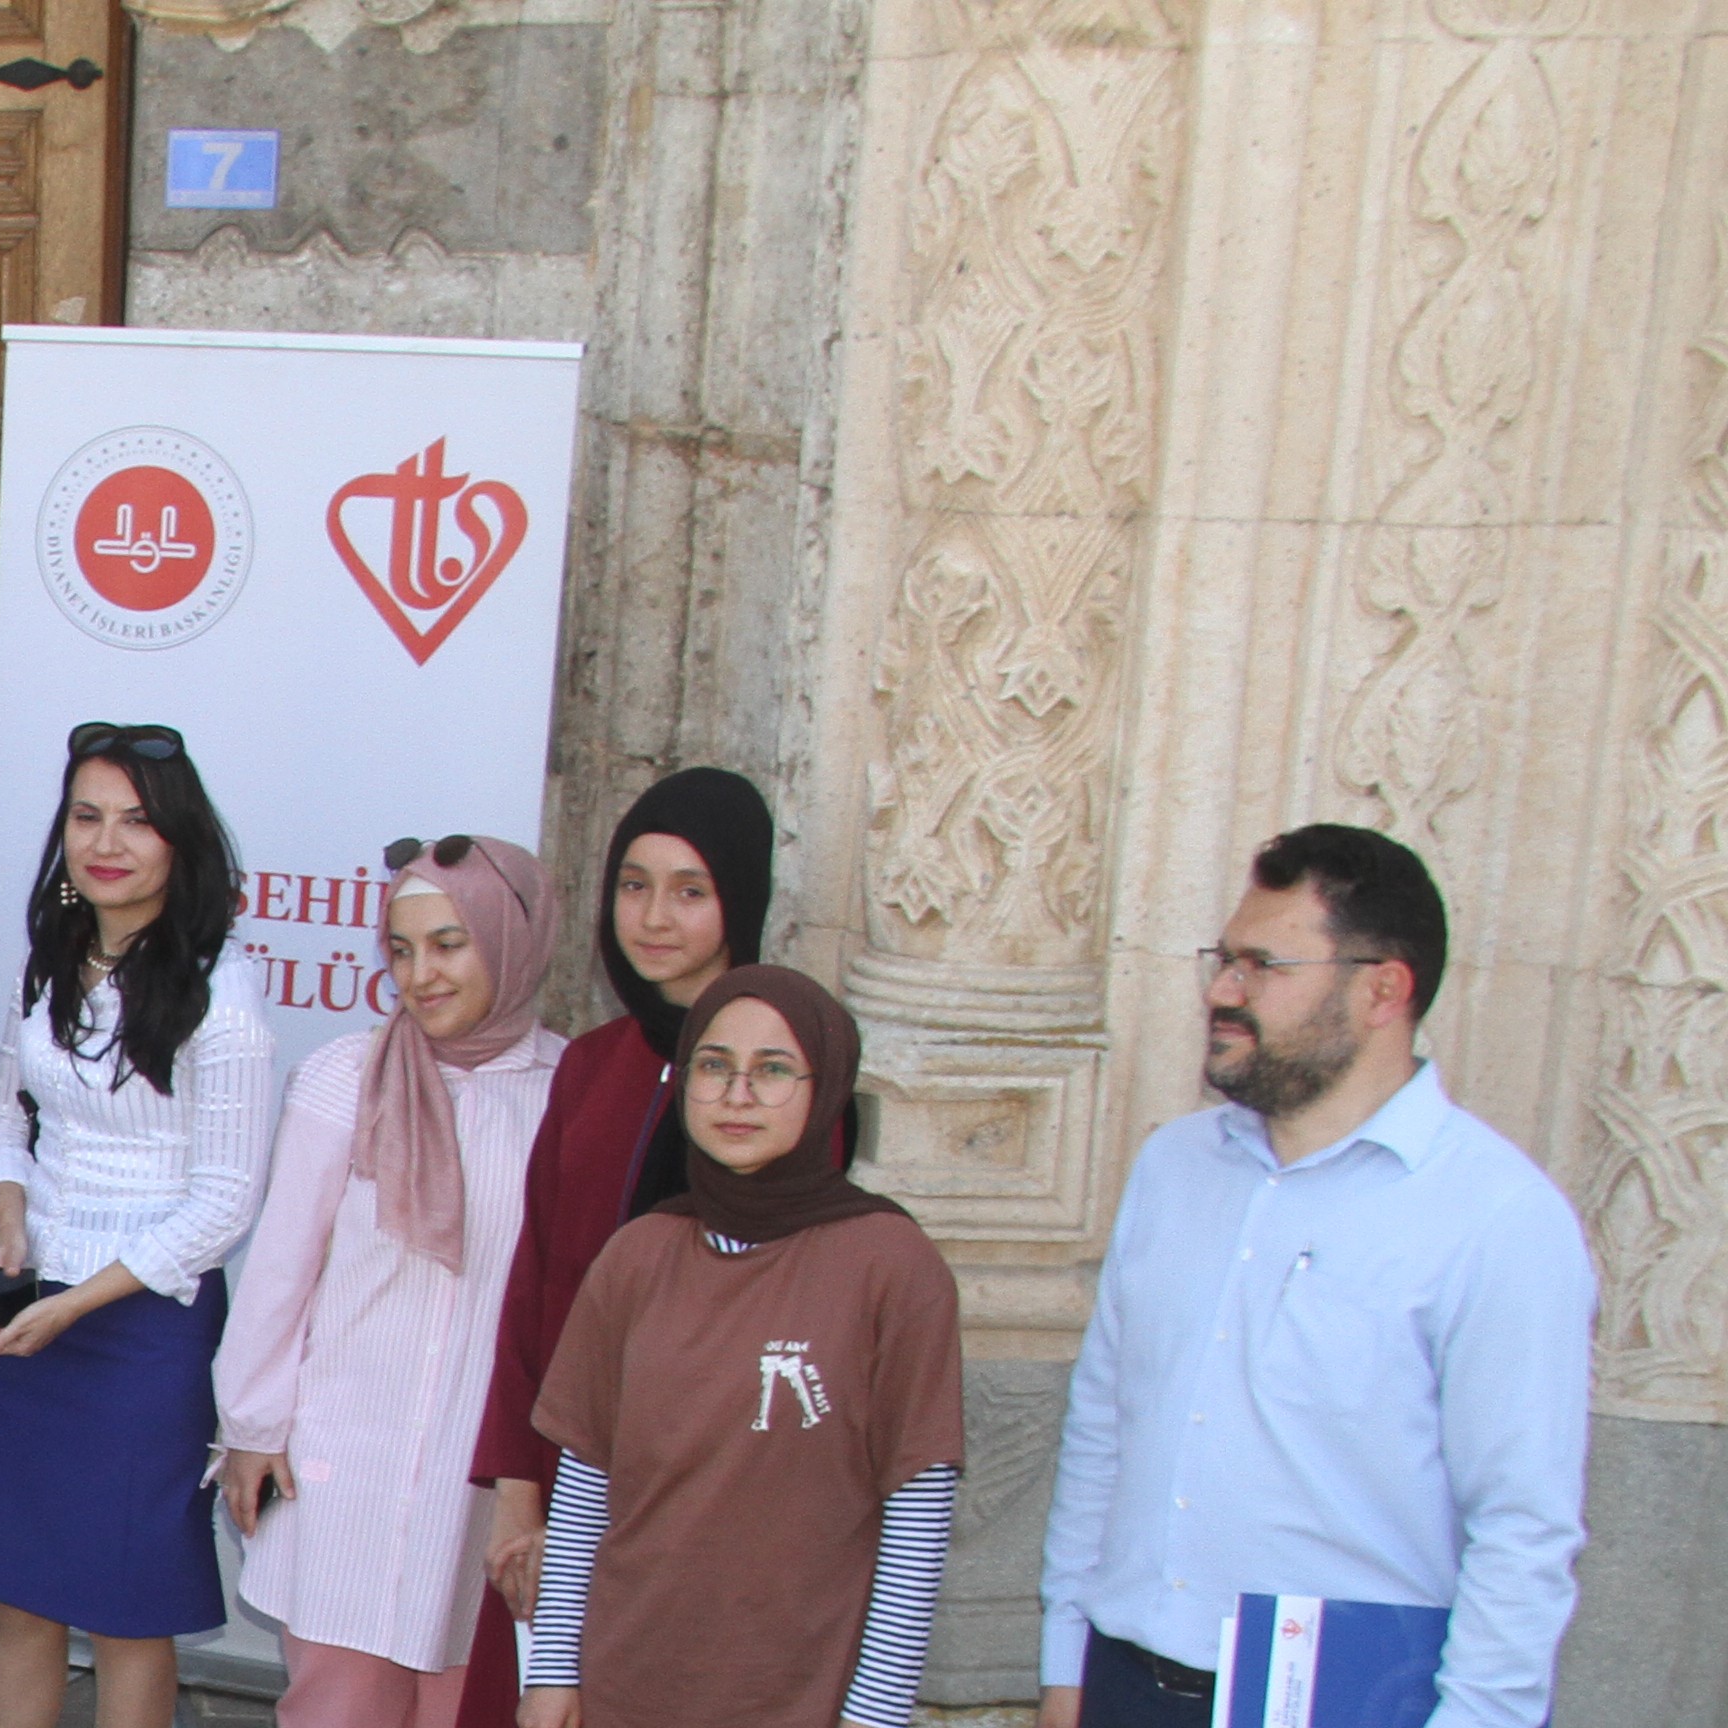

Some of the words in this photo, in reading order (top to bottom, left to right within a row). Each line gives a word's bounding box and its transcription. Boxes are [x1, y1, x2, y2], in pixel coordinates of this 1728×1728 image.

[202, 142, 244, 190] 7
[47, 536, 88, 614] DİYANET
[90, 611, 155, 639] İŞLERİ
[160, 545, 242, 637] BAŞKANLIĞI
